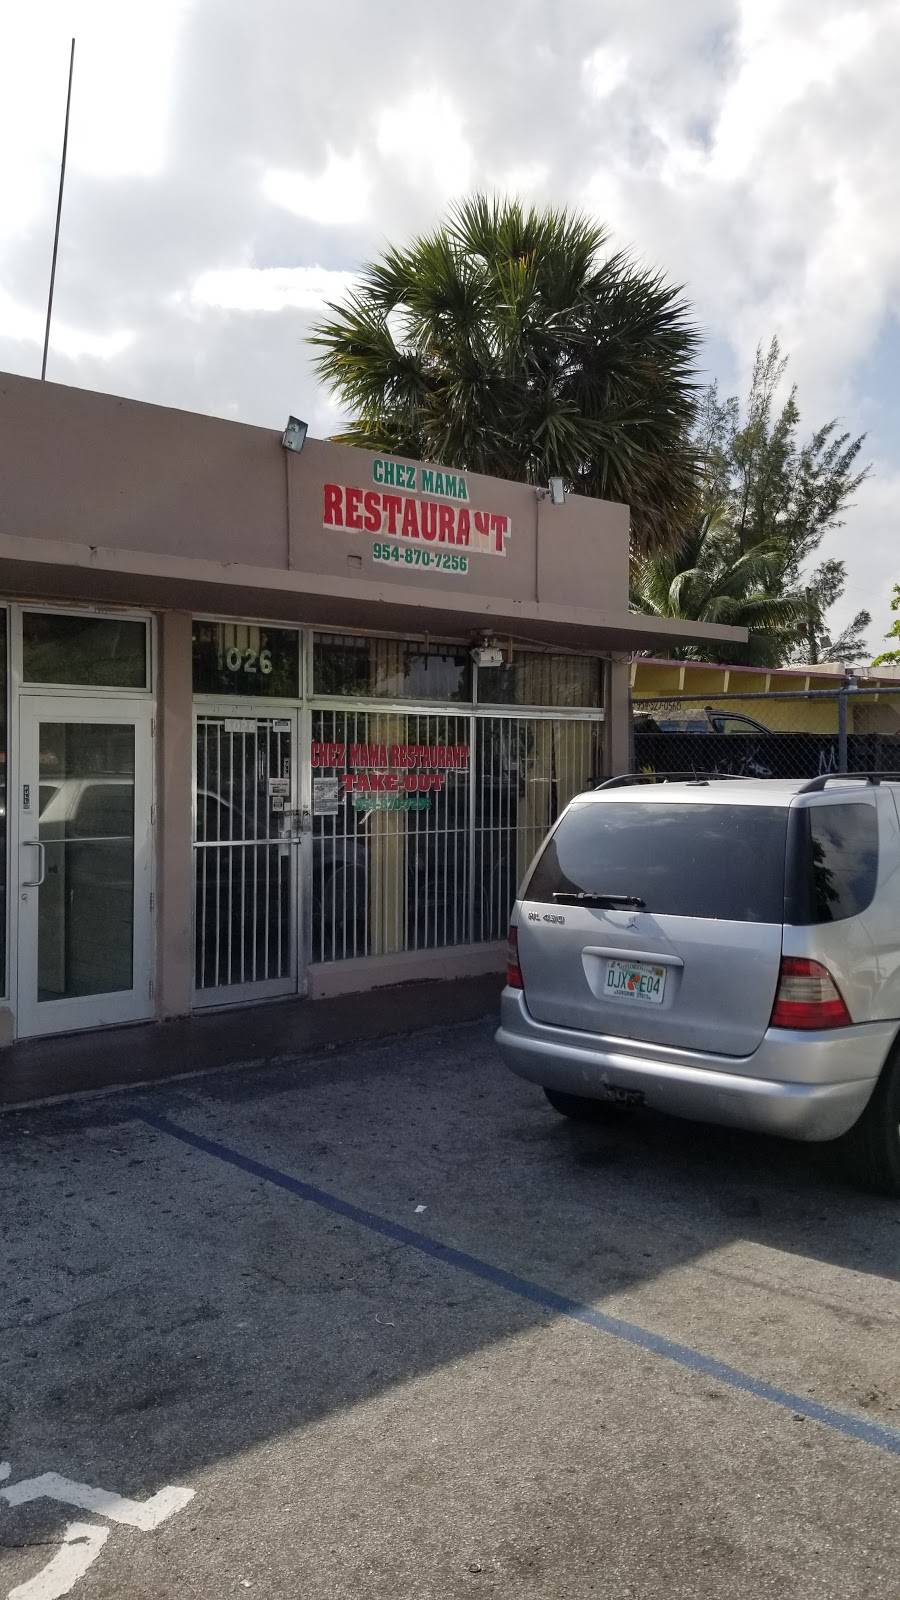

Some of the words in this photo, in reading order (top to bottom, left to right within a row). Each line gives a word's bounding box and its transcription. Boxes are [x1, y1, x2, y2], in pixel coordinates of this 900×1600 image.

[372, 459, 416, 489] CHEZ
[421, 469, 468, 499] MAMA
[373, 543, 468, 570] 954-870-7256
[311, 742, 345, 768] CHEZ
[349, 743, 388, 768] MAMA
[390, 745, 470, 769] RESTAURANT
